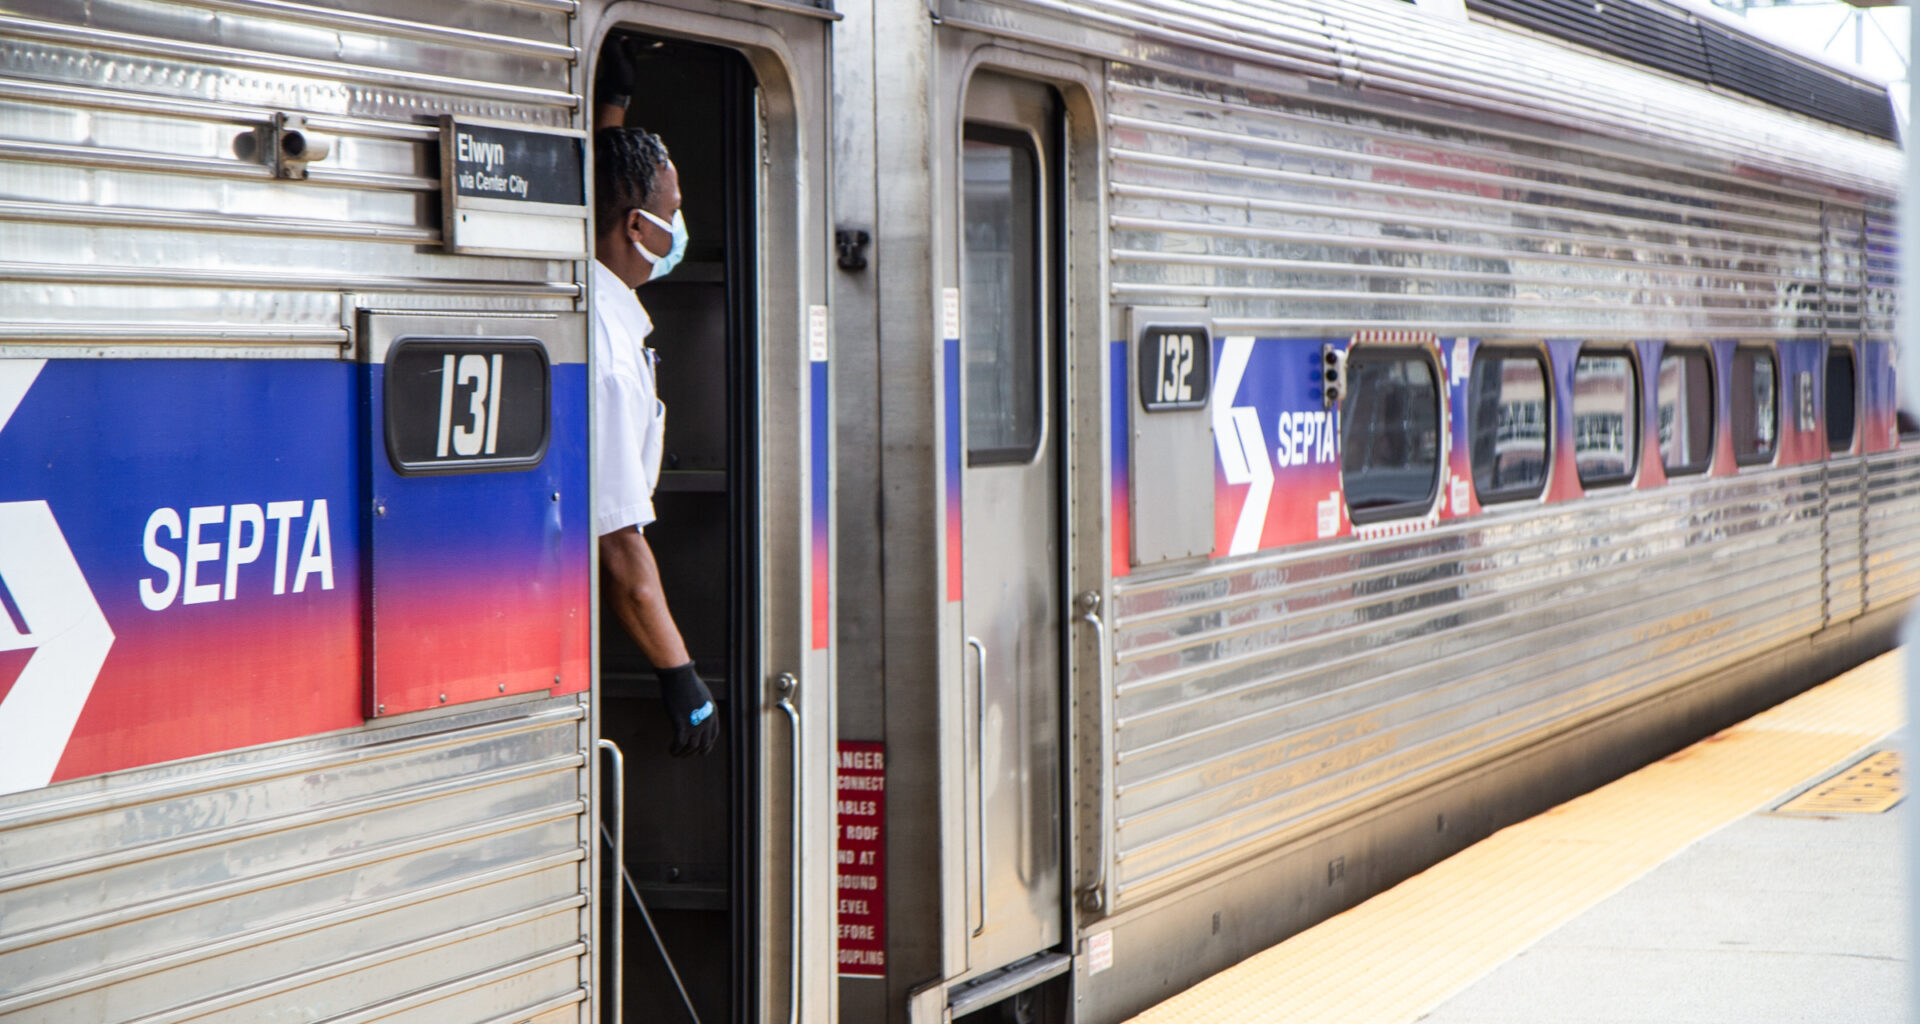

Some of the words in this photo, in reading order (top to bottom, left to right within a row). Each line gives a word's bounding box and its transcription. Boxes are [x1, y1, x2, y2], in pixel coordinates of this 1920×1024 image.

[457, 133, 504, 172] Elwyn
[459, 170, 475, 189] via
[475, 171, 508, 192] Center
[509, 174, 529, 198] City
[1156, 334, 1194, 402] 132
[436, 354, 503, 457] 131
[1277, 411, 1335, 468] SEPTA
[138, 499, 334, 611] SEPTA
[837, 800, 877, 816] ABLES
[846, 825, 879, 841] ROOF
[859, 851, 876, 865] AT
[837, 949, 885, 966] OUPLING
